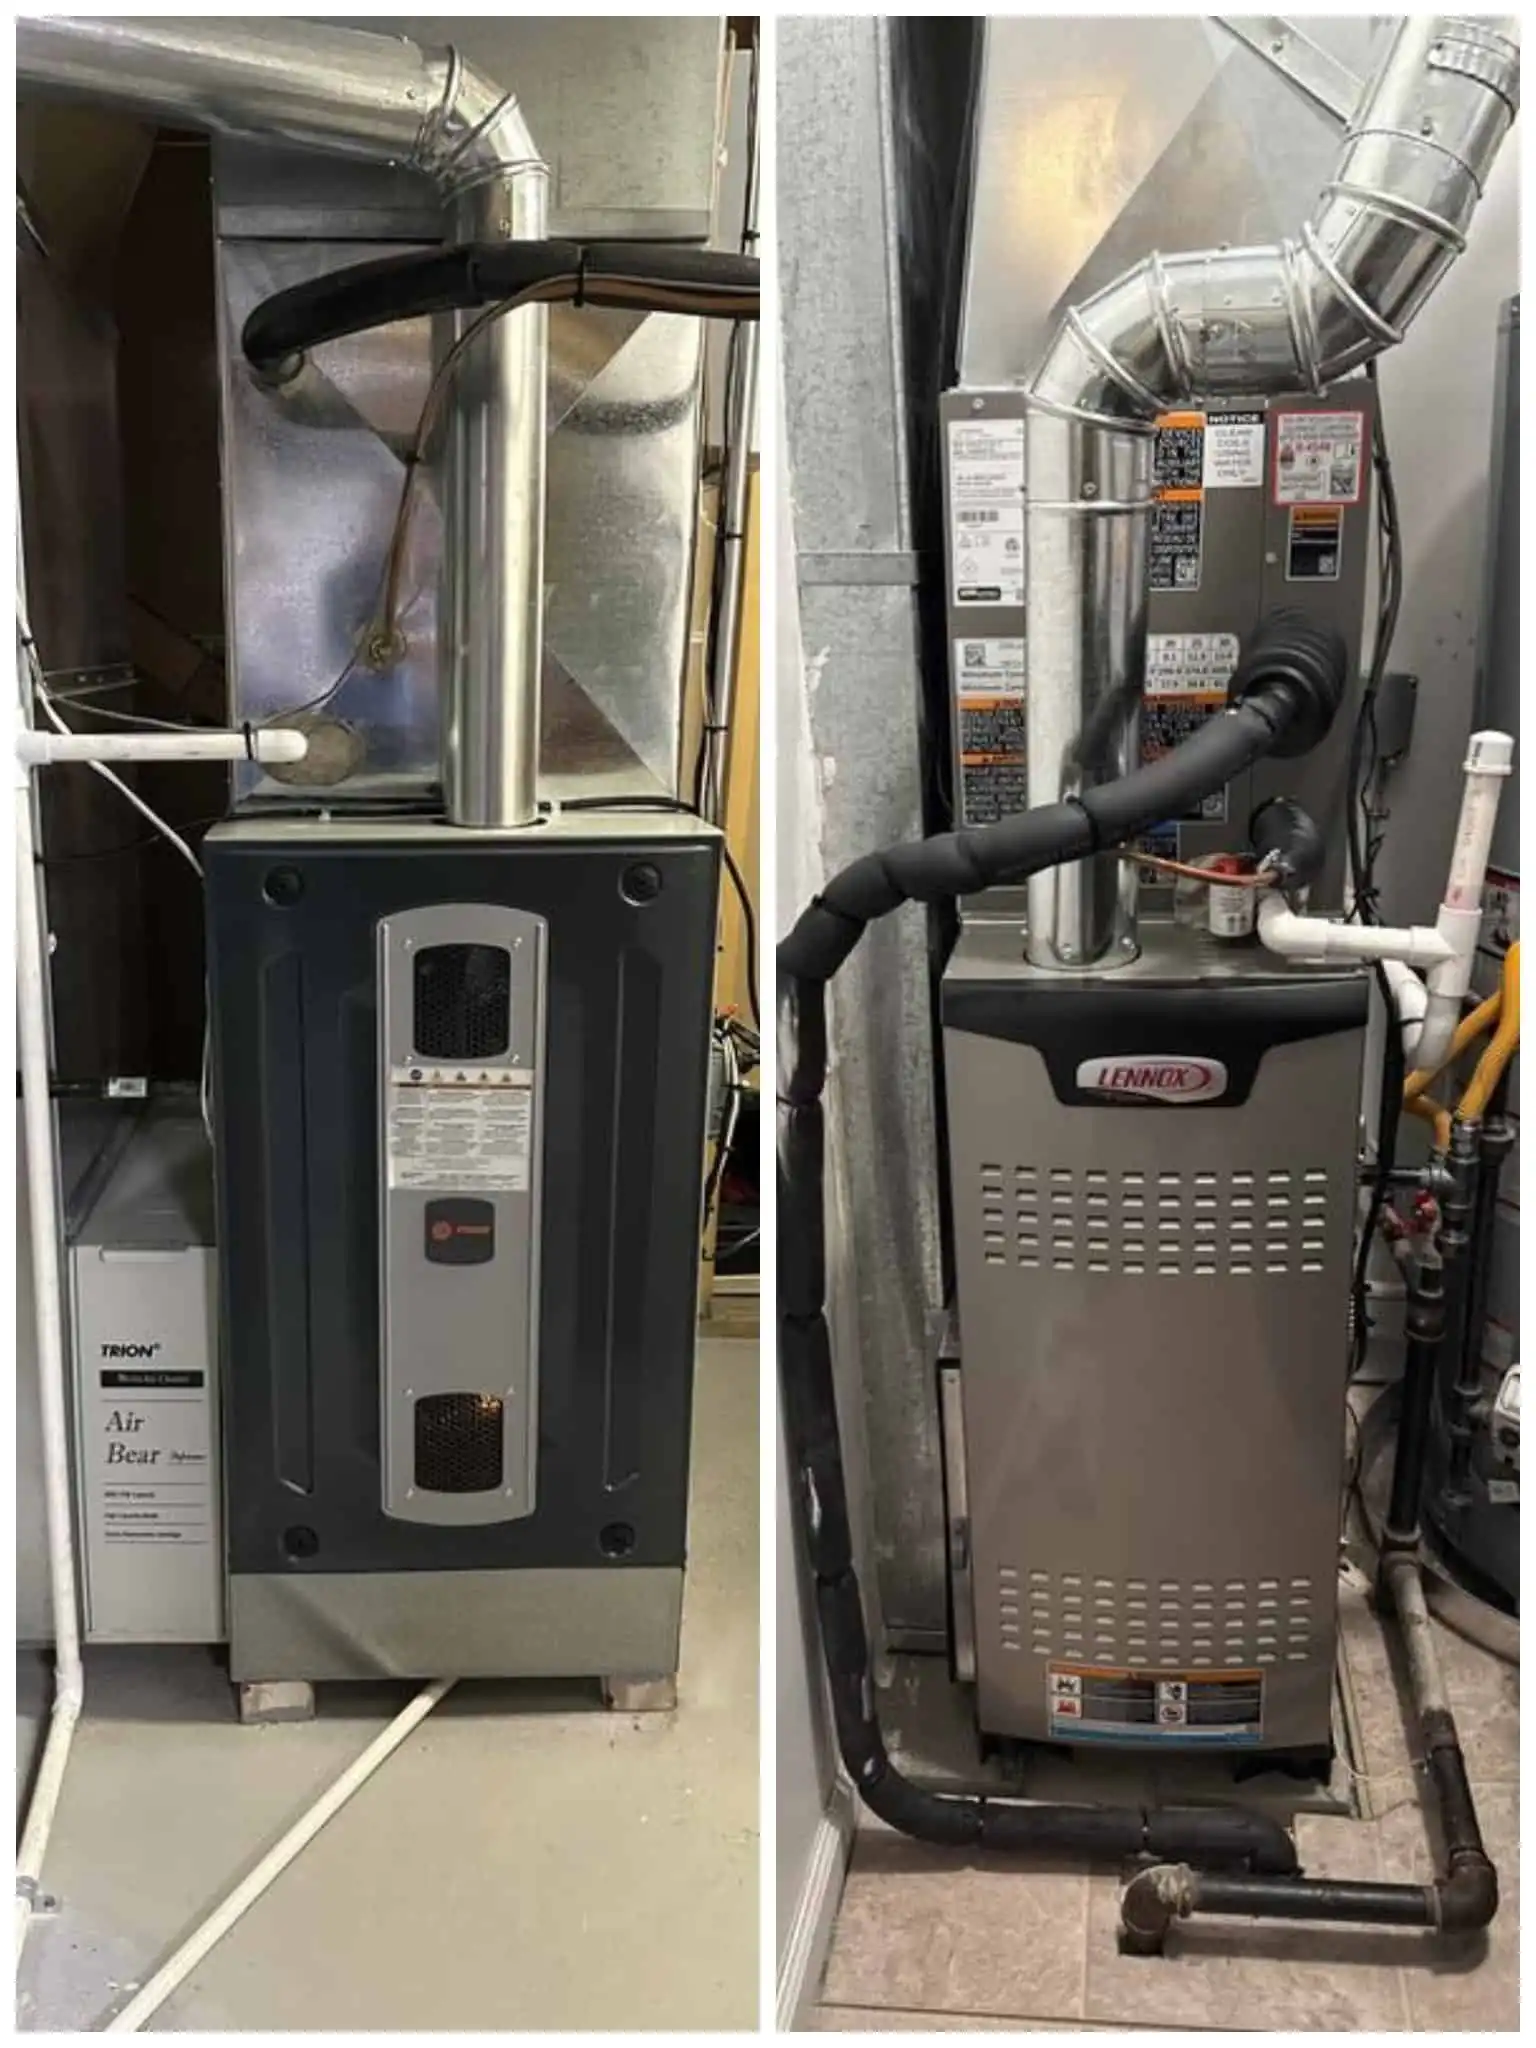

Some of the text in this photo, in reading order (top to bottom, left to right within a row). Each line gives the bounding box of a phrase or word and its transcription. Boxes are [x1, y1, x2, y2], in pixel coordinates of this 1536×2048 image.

[1099, 1066, 1189, 1089] LENNOX
[104, 1410, 146, 1432] Air
[105, 1441, 161, 1465] Bear
